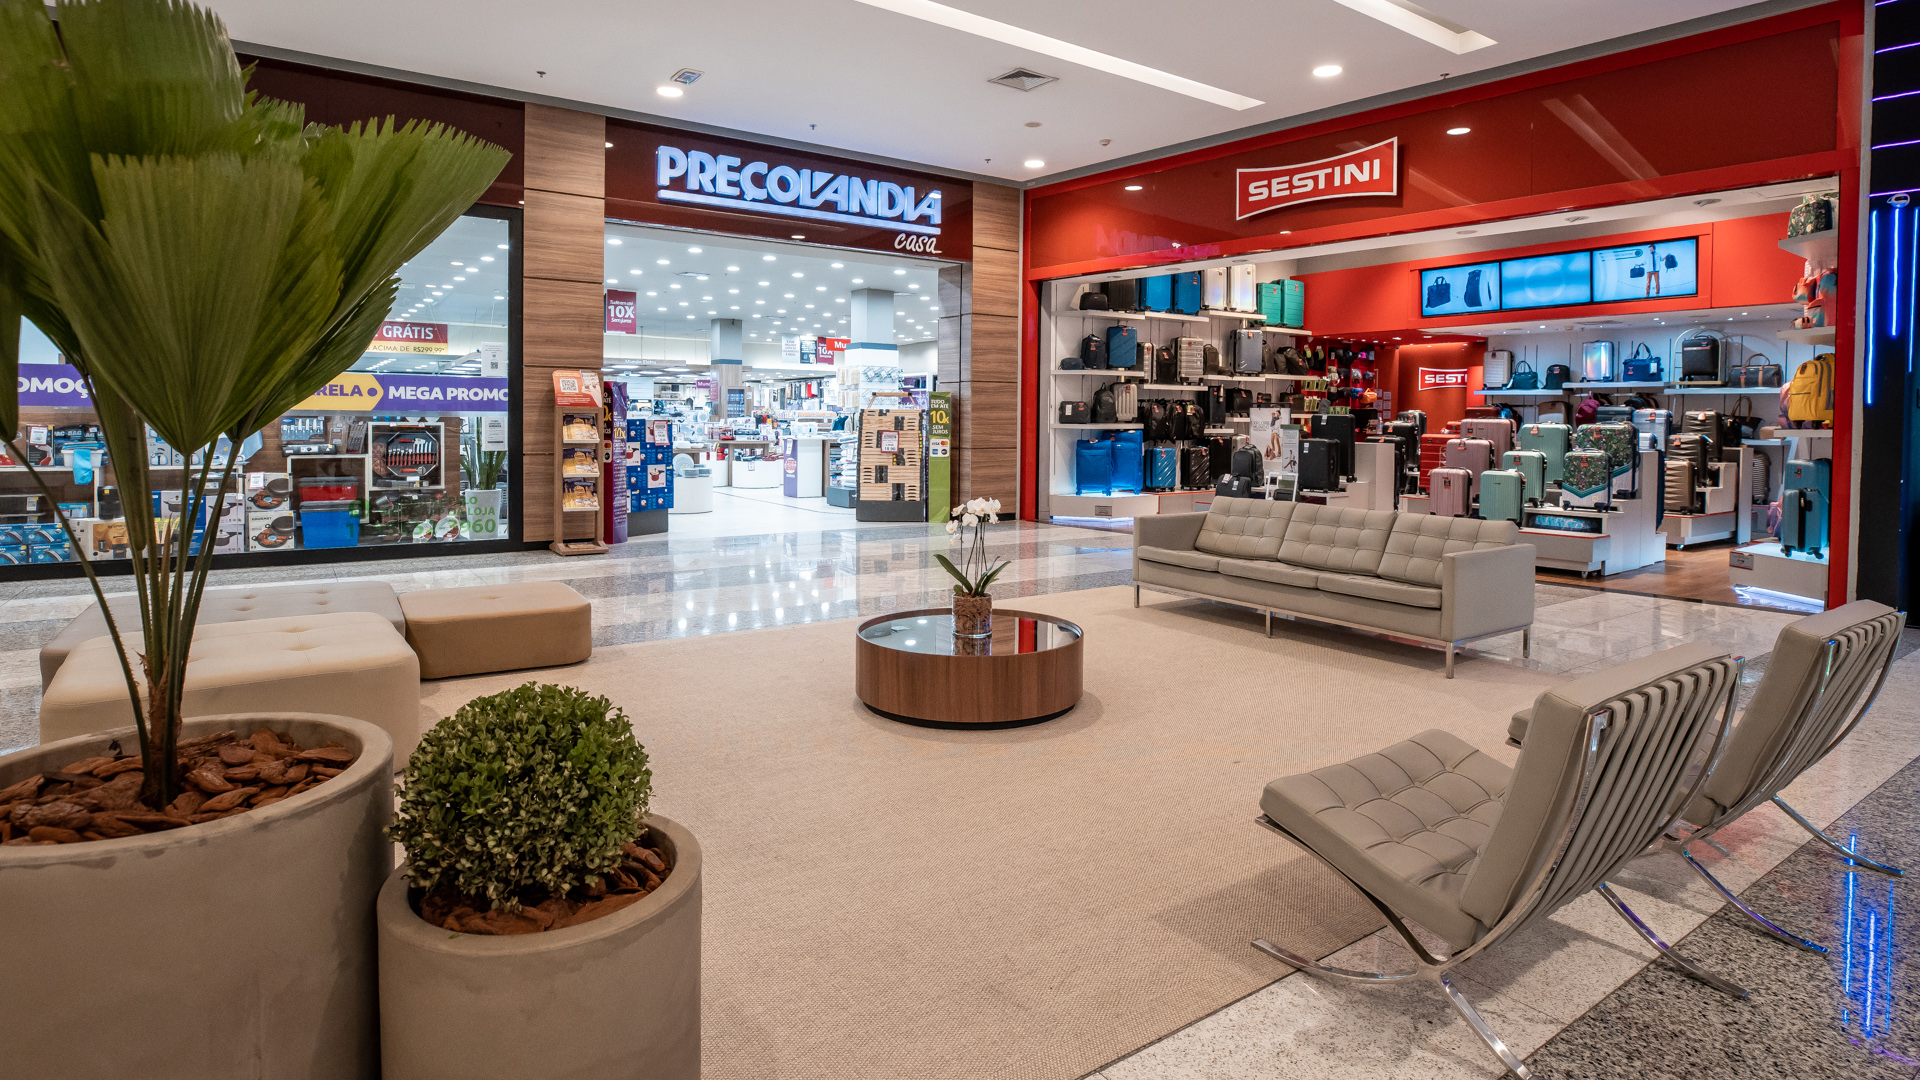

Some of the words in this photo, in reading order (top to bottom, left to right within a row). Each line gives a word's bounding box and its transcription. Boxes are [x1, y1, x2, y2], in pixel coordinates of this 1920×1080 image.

[657, 145, 942, 225] PREÇOLANDIA
[1248, 158, 1381, 202] SESTINI
[894, 233, 942, 254] casa
[388, 386, 444, 400] MEGA
[467, 506, 496, 516] LOJA
